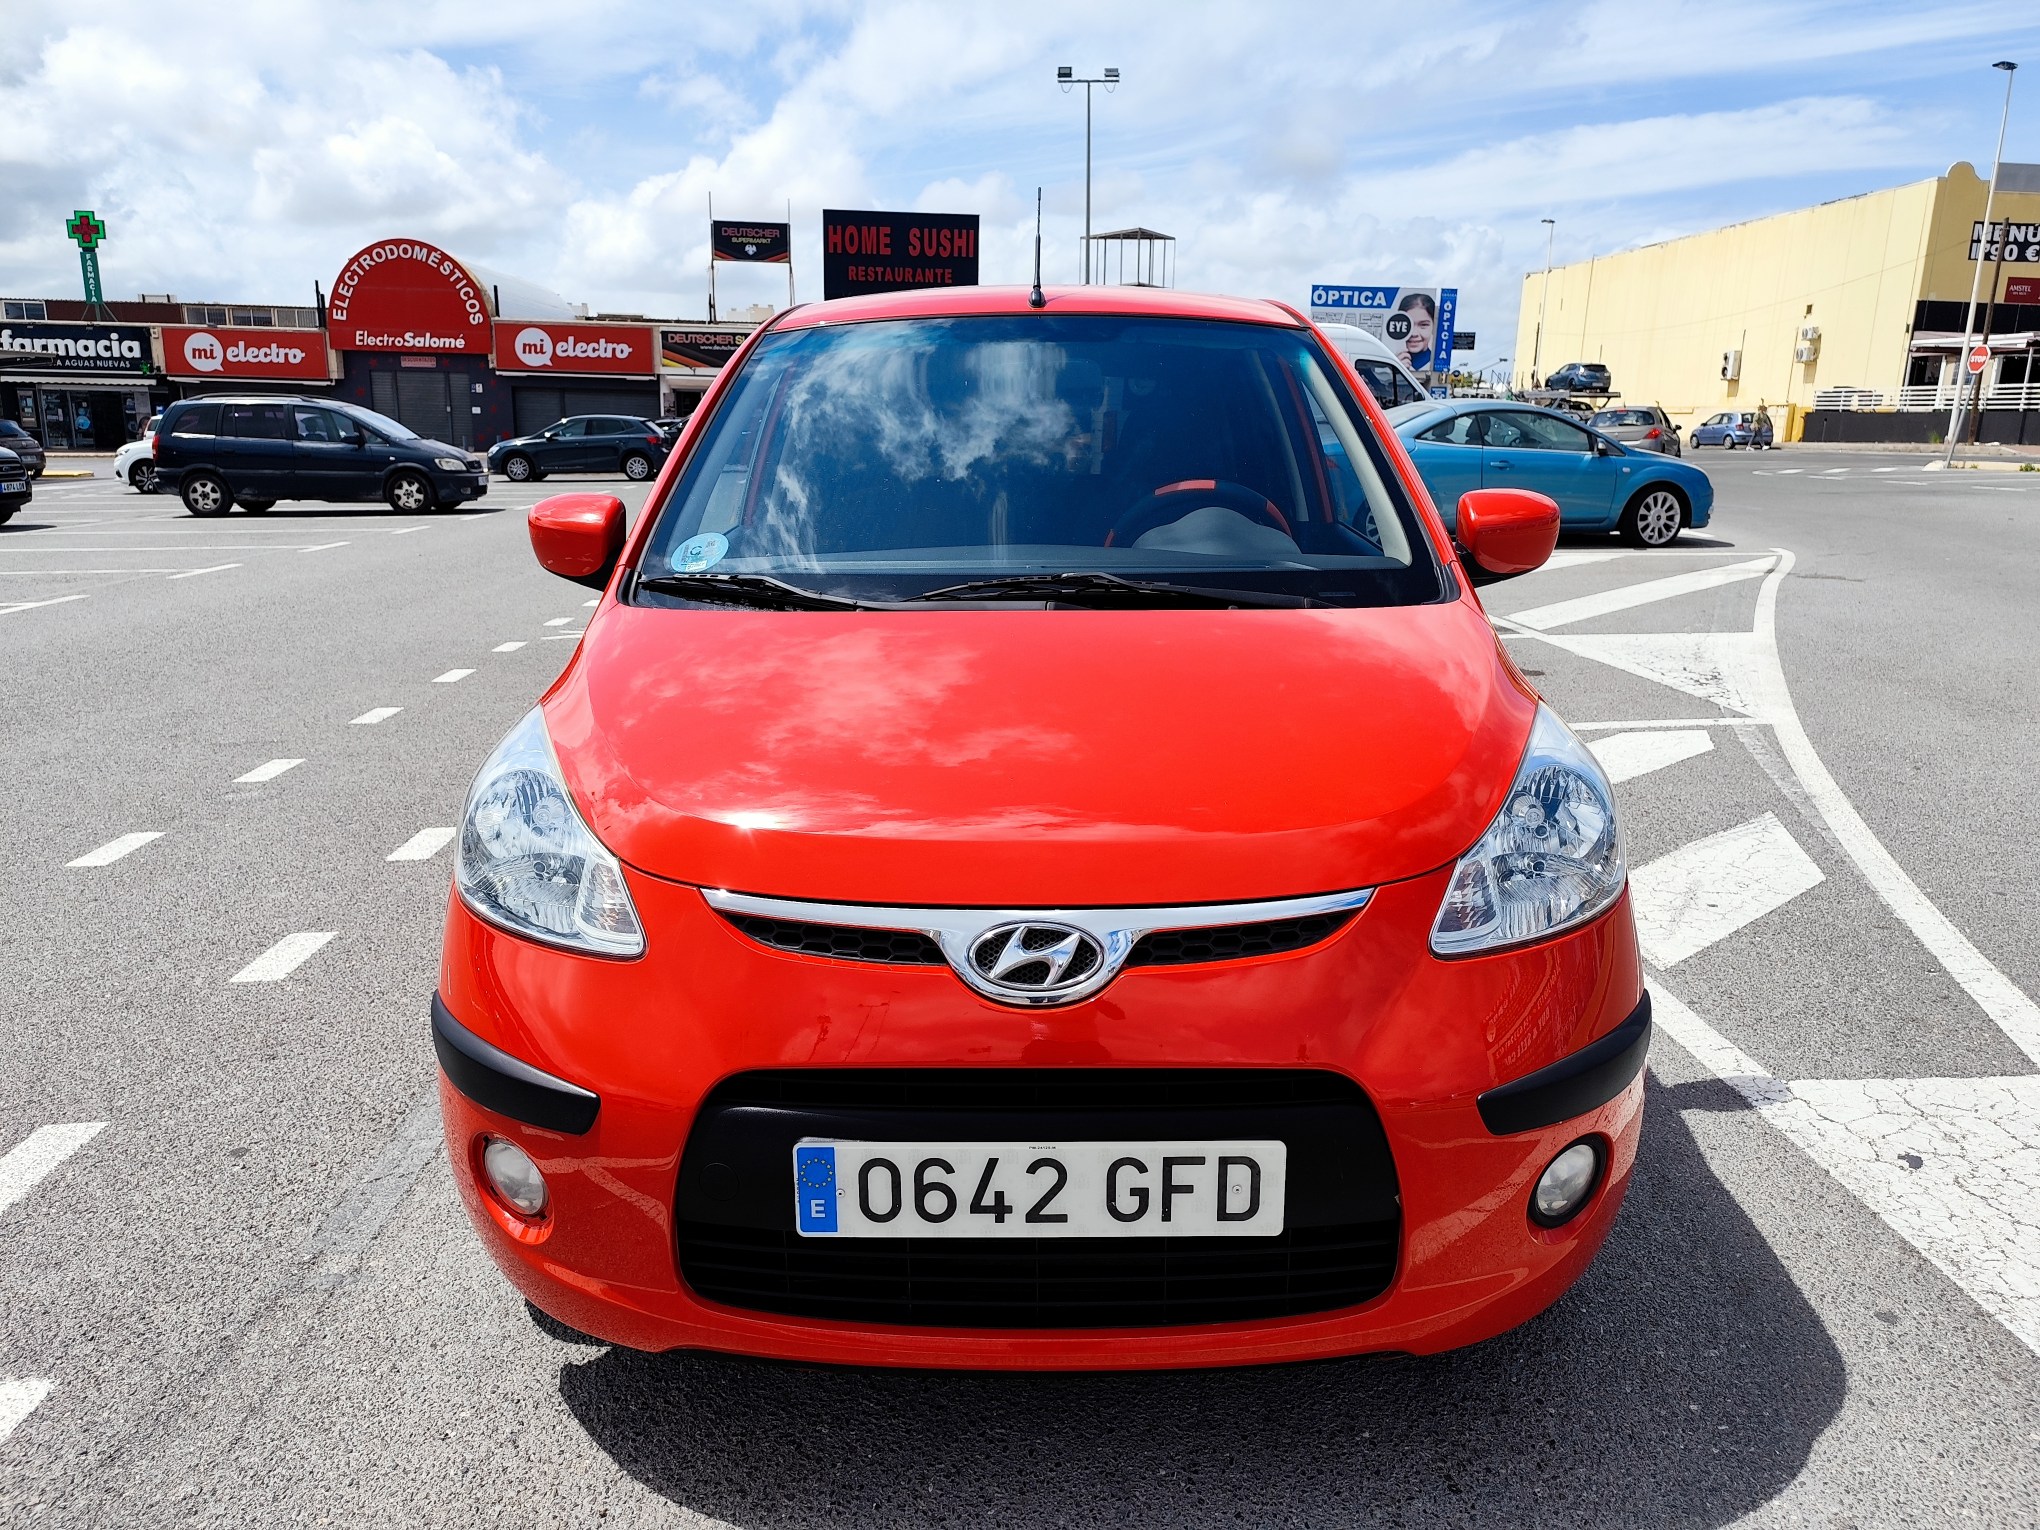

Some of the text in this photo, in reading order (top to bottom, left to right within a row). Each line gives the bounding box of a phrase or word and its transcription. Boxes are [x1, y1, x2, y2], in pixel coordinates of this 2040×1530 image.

[721, 227, 780, 238] DEUTSCHER
[828, 225, 975, 257] HOME SUSHI
[86, 253, 98, 303] FARMACIA
[848, 265, 952, 284] RESTAURANTE
[332, 243, 483, 326] ELECTRODOMÉSTICOS
[1313, 286, 1386, 306] ÓPTICA
[1389, 321, 1408, 333] EYE
[0, 329, 142, 358] farmacia
[355, 330, 466, 349] ElectroSalomé
[522, 335, 633, 360] mi electro
[667, 333, 734, 345] DEUTSCHER
[192, 340, 306, 364] mi electro
[1970, 355, 1986, 363] STOP
[65, 359, 95, 367] AGUAS
[97, 360, 131, 368] NUEVAS
[857, 1156, 1263, 1224] 0642 GFD
[811, 1199, 826, 1218] E
